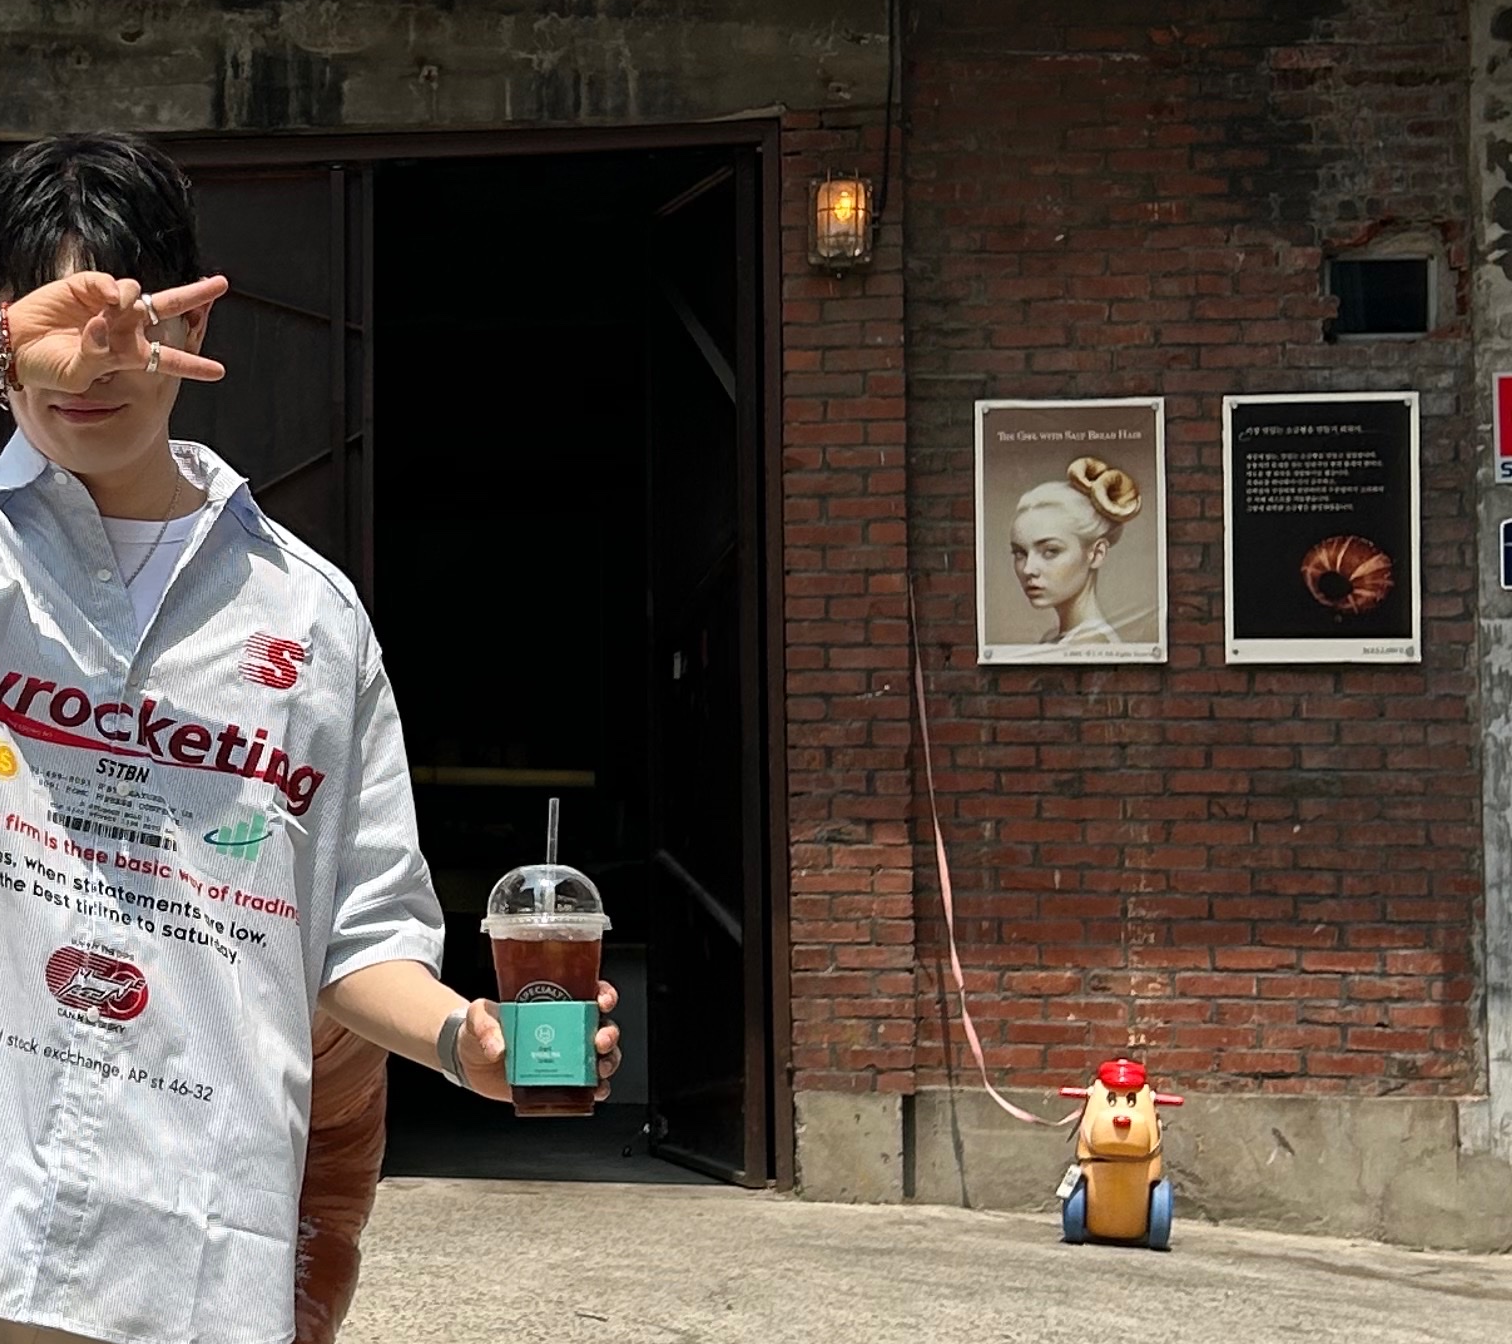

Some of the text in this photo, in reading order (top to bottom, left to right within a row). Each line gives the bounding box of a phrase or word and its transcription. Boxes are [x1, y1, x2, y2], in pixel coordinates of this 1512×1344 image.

[6, 813, 41, 842] firm
[114, 851, 172, 879] basic
[208, 885, 230, 902] of
[0, 871, 26, 892] the
[33, 879, 70, 909] best
[137, 914, 156, 933] to
[24, 856, 67, 885] when
[230, 920, 267, 948] low,
[128, 1067, 148, 1085] AP
[150, 1075, 165, 1091] st
[168, 1079, 214, 1103] 46-32
